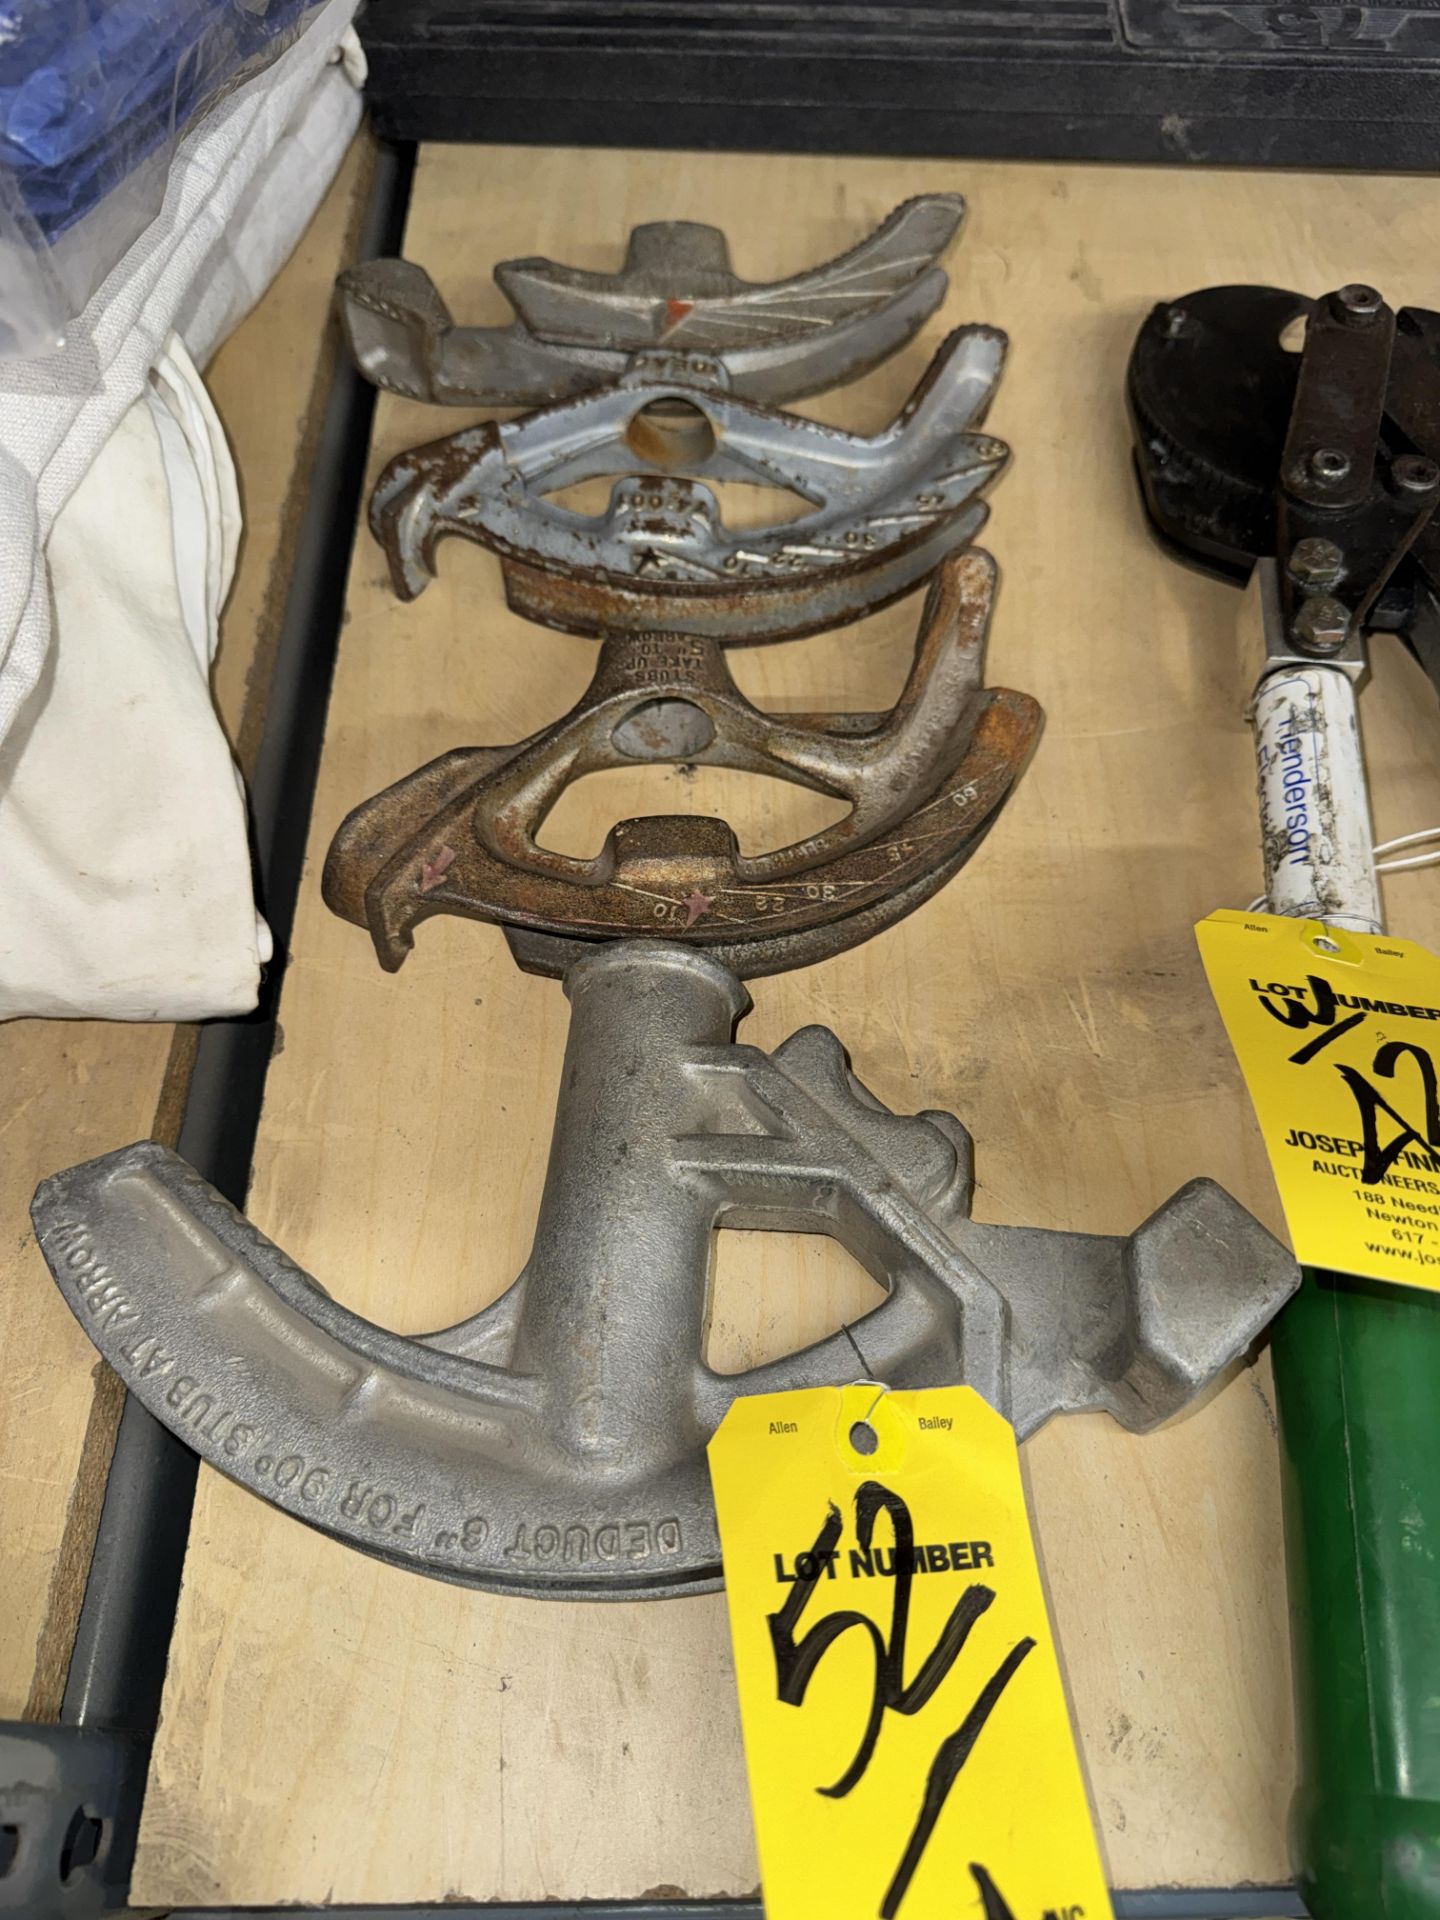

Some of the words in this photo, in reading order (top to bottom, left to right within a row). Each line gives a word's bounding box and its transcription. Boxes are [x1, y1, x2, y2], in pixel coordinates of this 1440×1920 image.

[641, 643, 662, 656] TO
[624, 655, 649, 671] UP
[659, 655, 704, 671] TAKE
[635, 670, 697, 683] STUBS
[952, 786, 978, 808] 60
[755, 895, 786, 912] 22
[807, 884, 837, 901] 30
[653, 902, 679, 919] 10
[1244, 923, 1268, 933] Allen
[1249, 978, 1307, 1000] LOT
[1285, 1129, 1369, 1158] JOSEP
[1313, 1160, 1440, 1196] AUCTNEERS
[1353, 1189, 1386, 1205] 188
[1391, 1196, 1440, 1216] Need
[1366, 1207, 1439, 1232] Newton
[1391, 1228, 1424, 1244] 617
[51, 1220, 143, 1334] ARROW
[119, 1337, 176, 1378] AT
[166, 1375, 256, 1457] STUB
[768, 1421, 799, 1435] Allen
[918, 1417, 954, 1430] Bailey
[340, 1481, 425, 1538] FOR
[505, 1517, 684, 1562] DEDUCT
[773, 1551, 841, 1583] LOT
[849, 1541, 995, 1579] NUMBER
